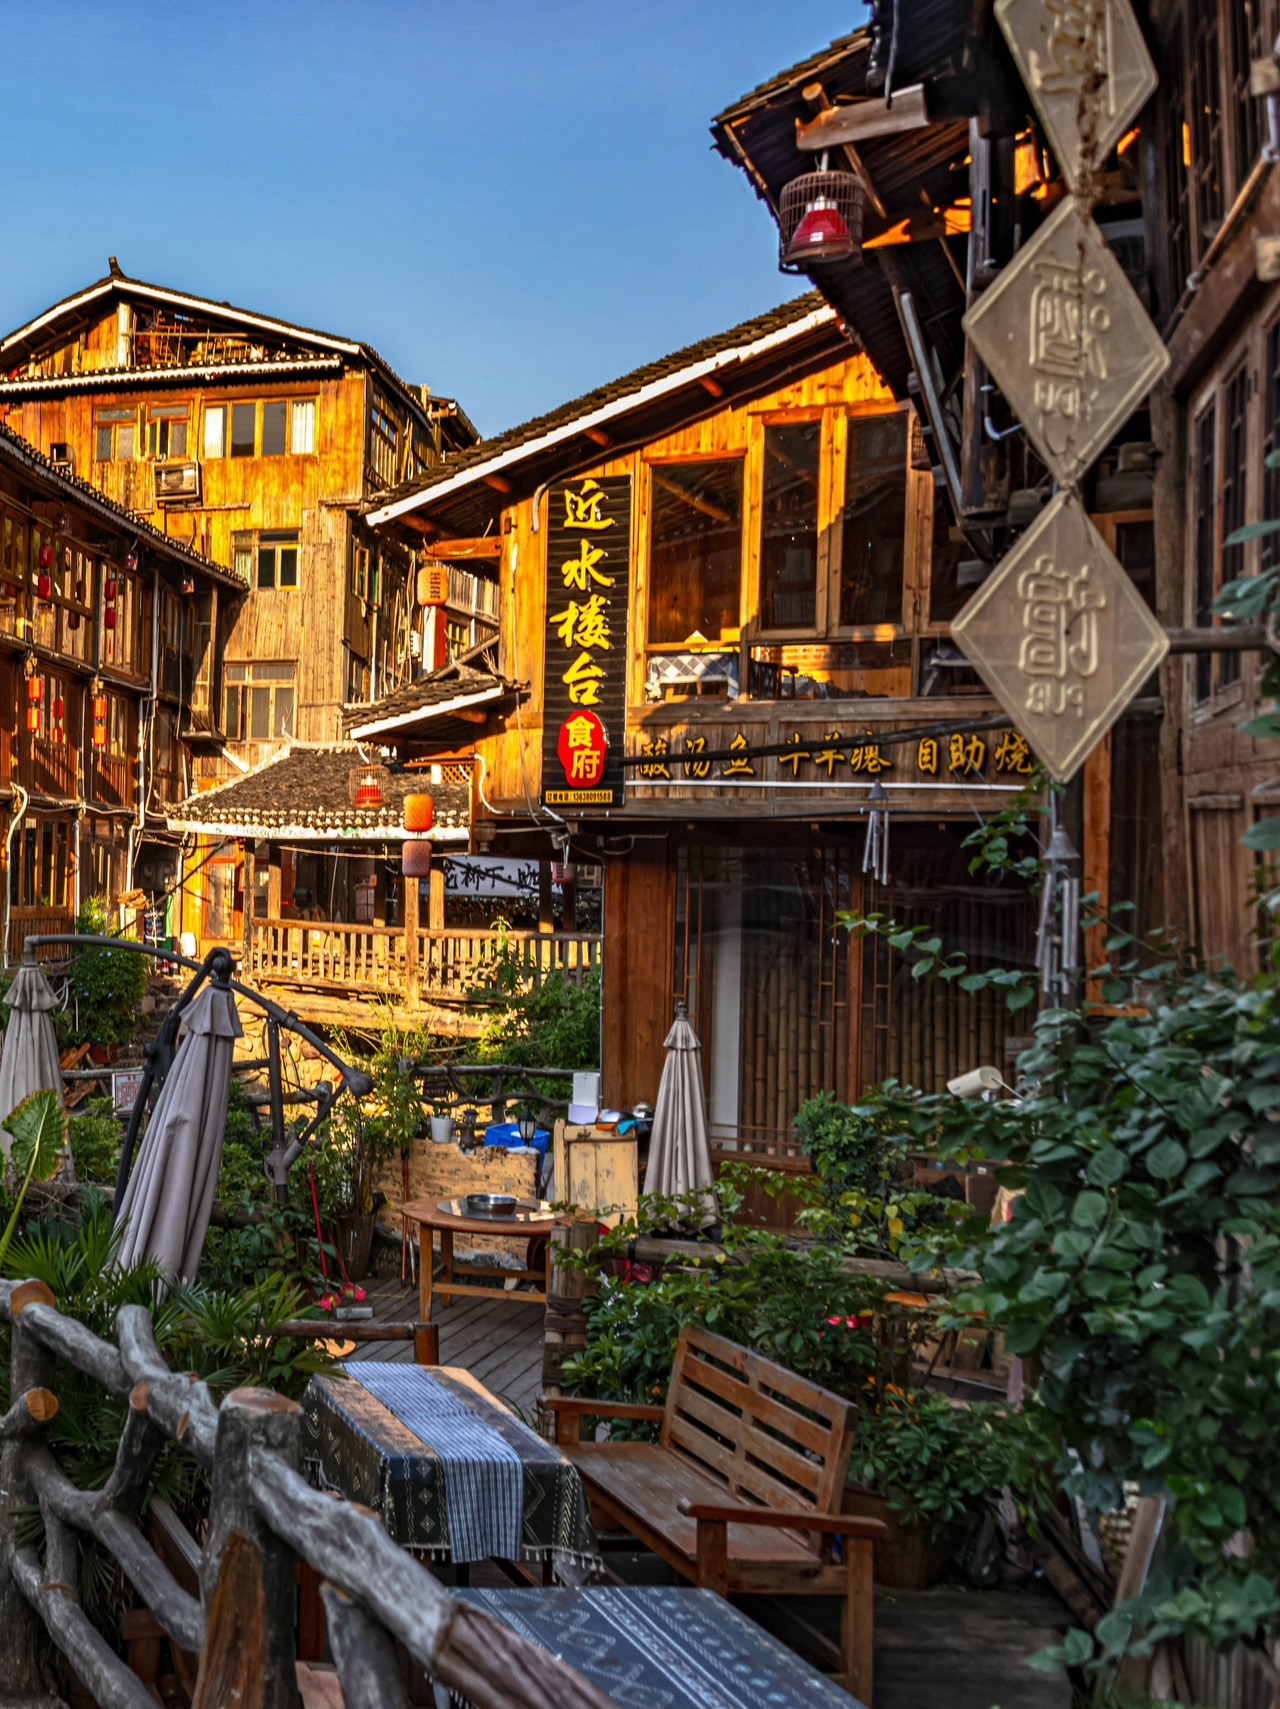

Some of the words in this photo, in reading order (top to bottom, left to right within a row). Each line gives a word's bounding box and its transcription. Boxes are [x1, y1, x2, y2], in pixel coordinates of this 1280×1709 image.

[549, 479, 613, 705] 近水楼台
[565, 715, 601, 779] 食府
[640, 732, 754, 779] 酸汤鱼
